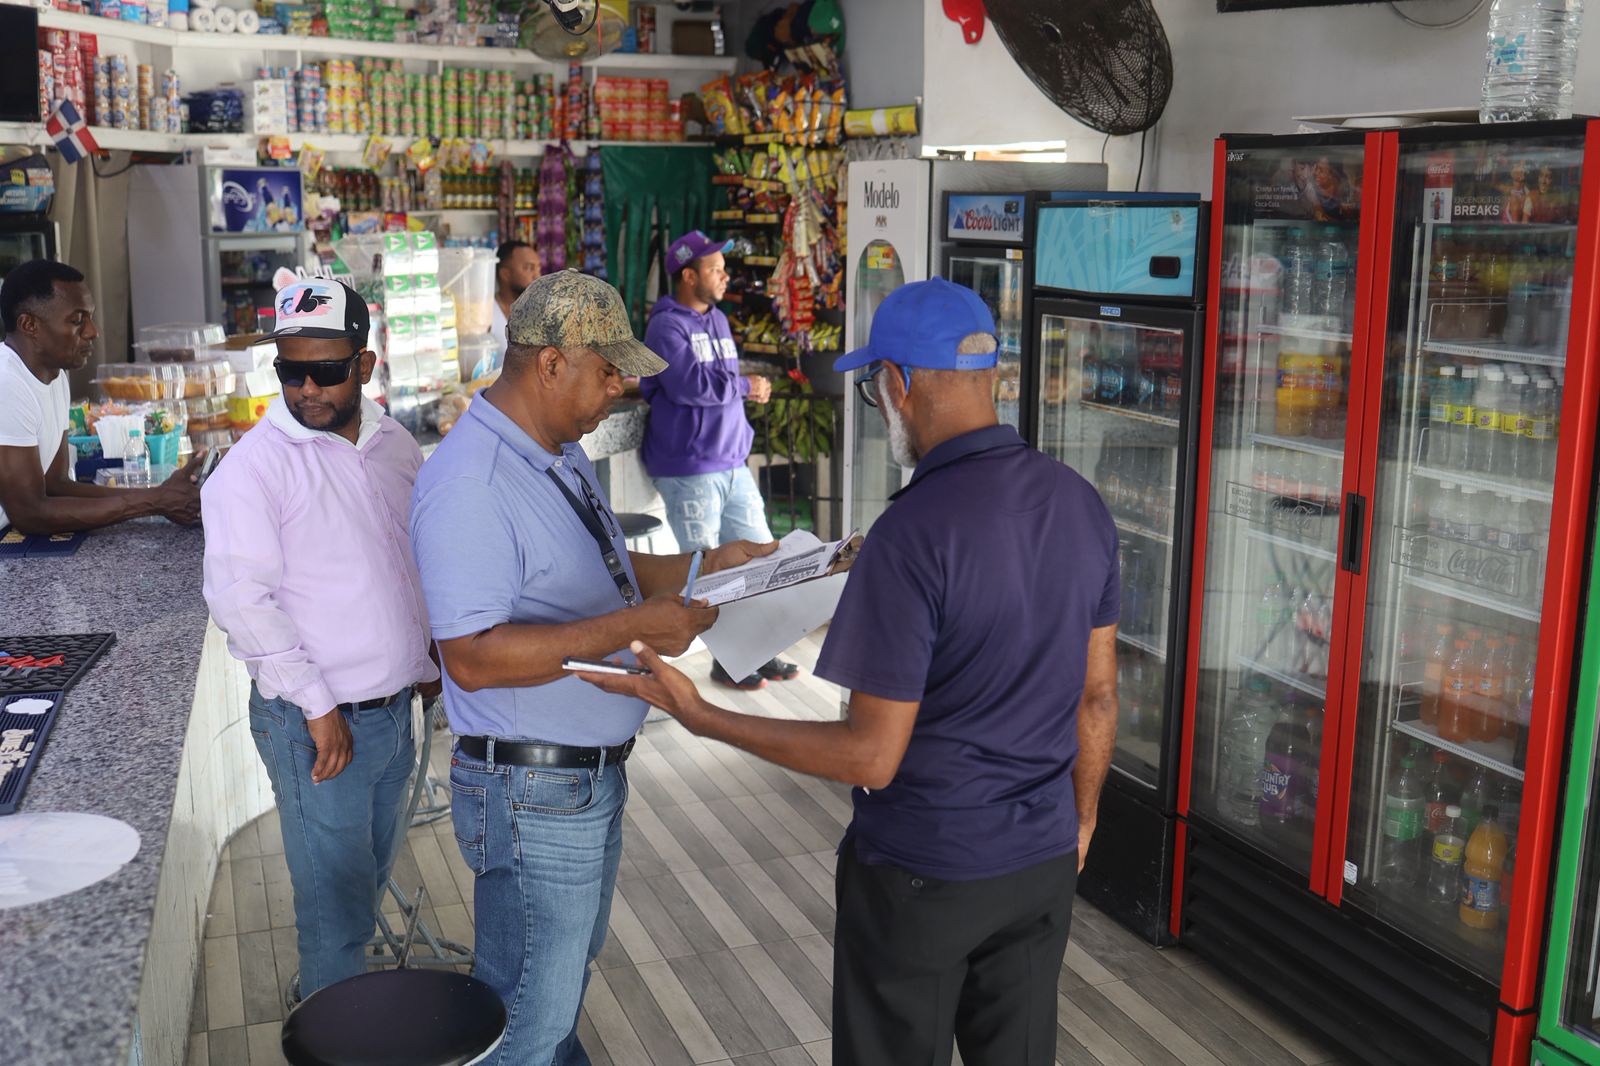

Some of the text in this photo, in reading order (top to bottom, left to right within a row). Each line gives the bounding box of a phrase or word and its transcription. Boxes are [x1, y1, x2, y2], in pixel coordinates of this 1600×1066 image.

[864, 181, 899, 208] Modelo
[1454, 205, 1500, 216] BREAKS
[965, 209, 1021, 231] Coors LIGHT
[1263, 771, 1291, 786] UNTRY
[1263, 781, 1279, 796] LUB
